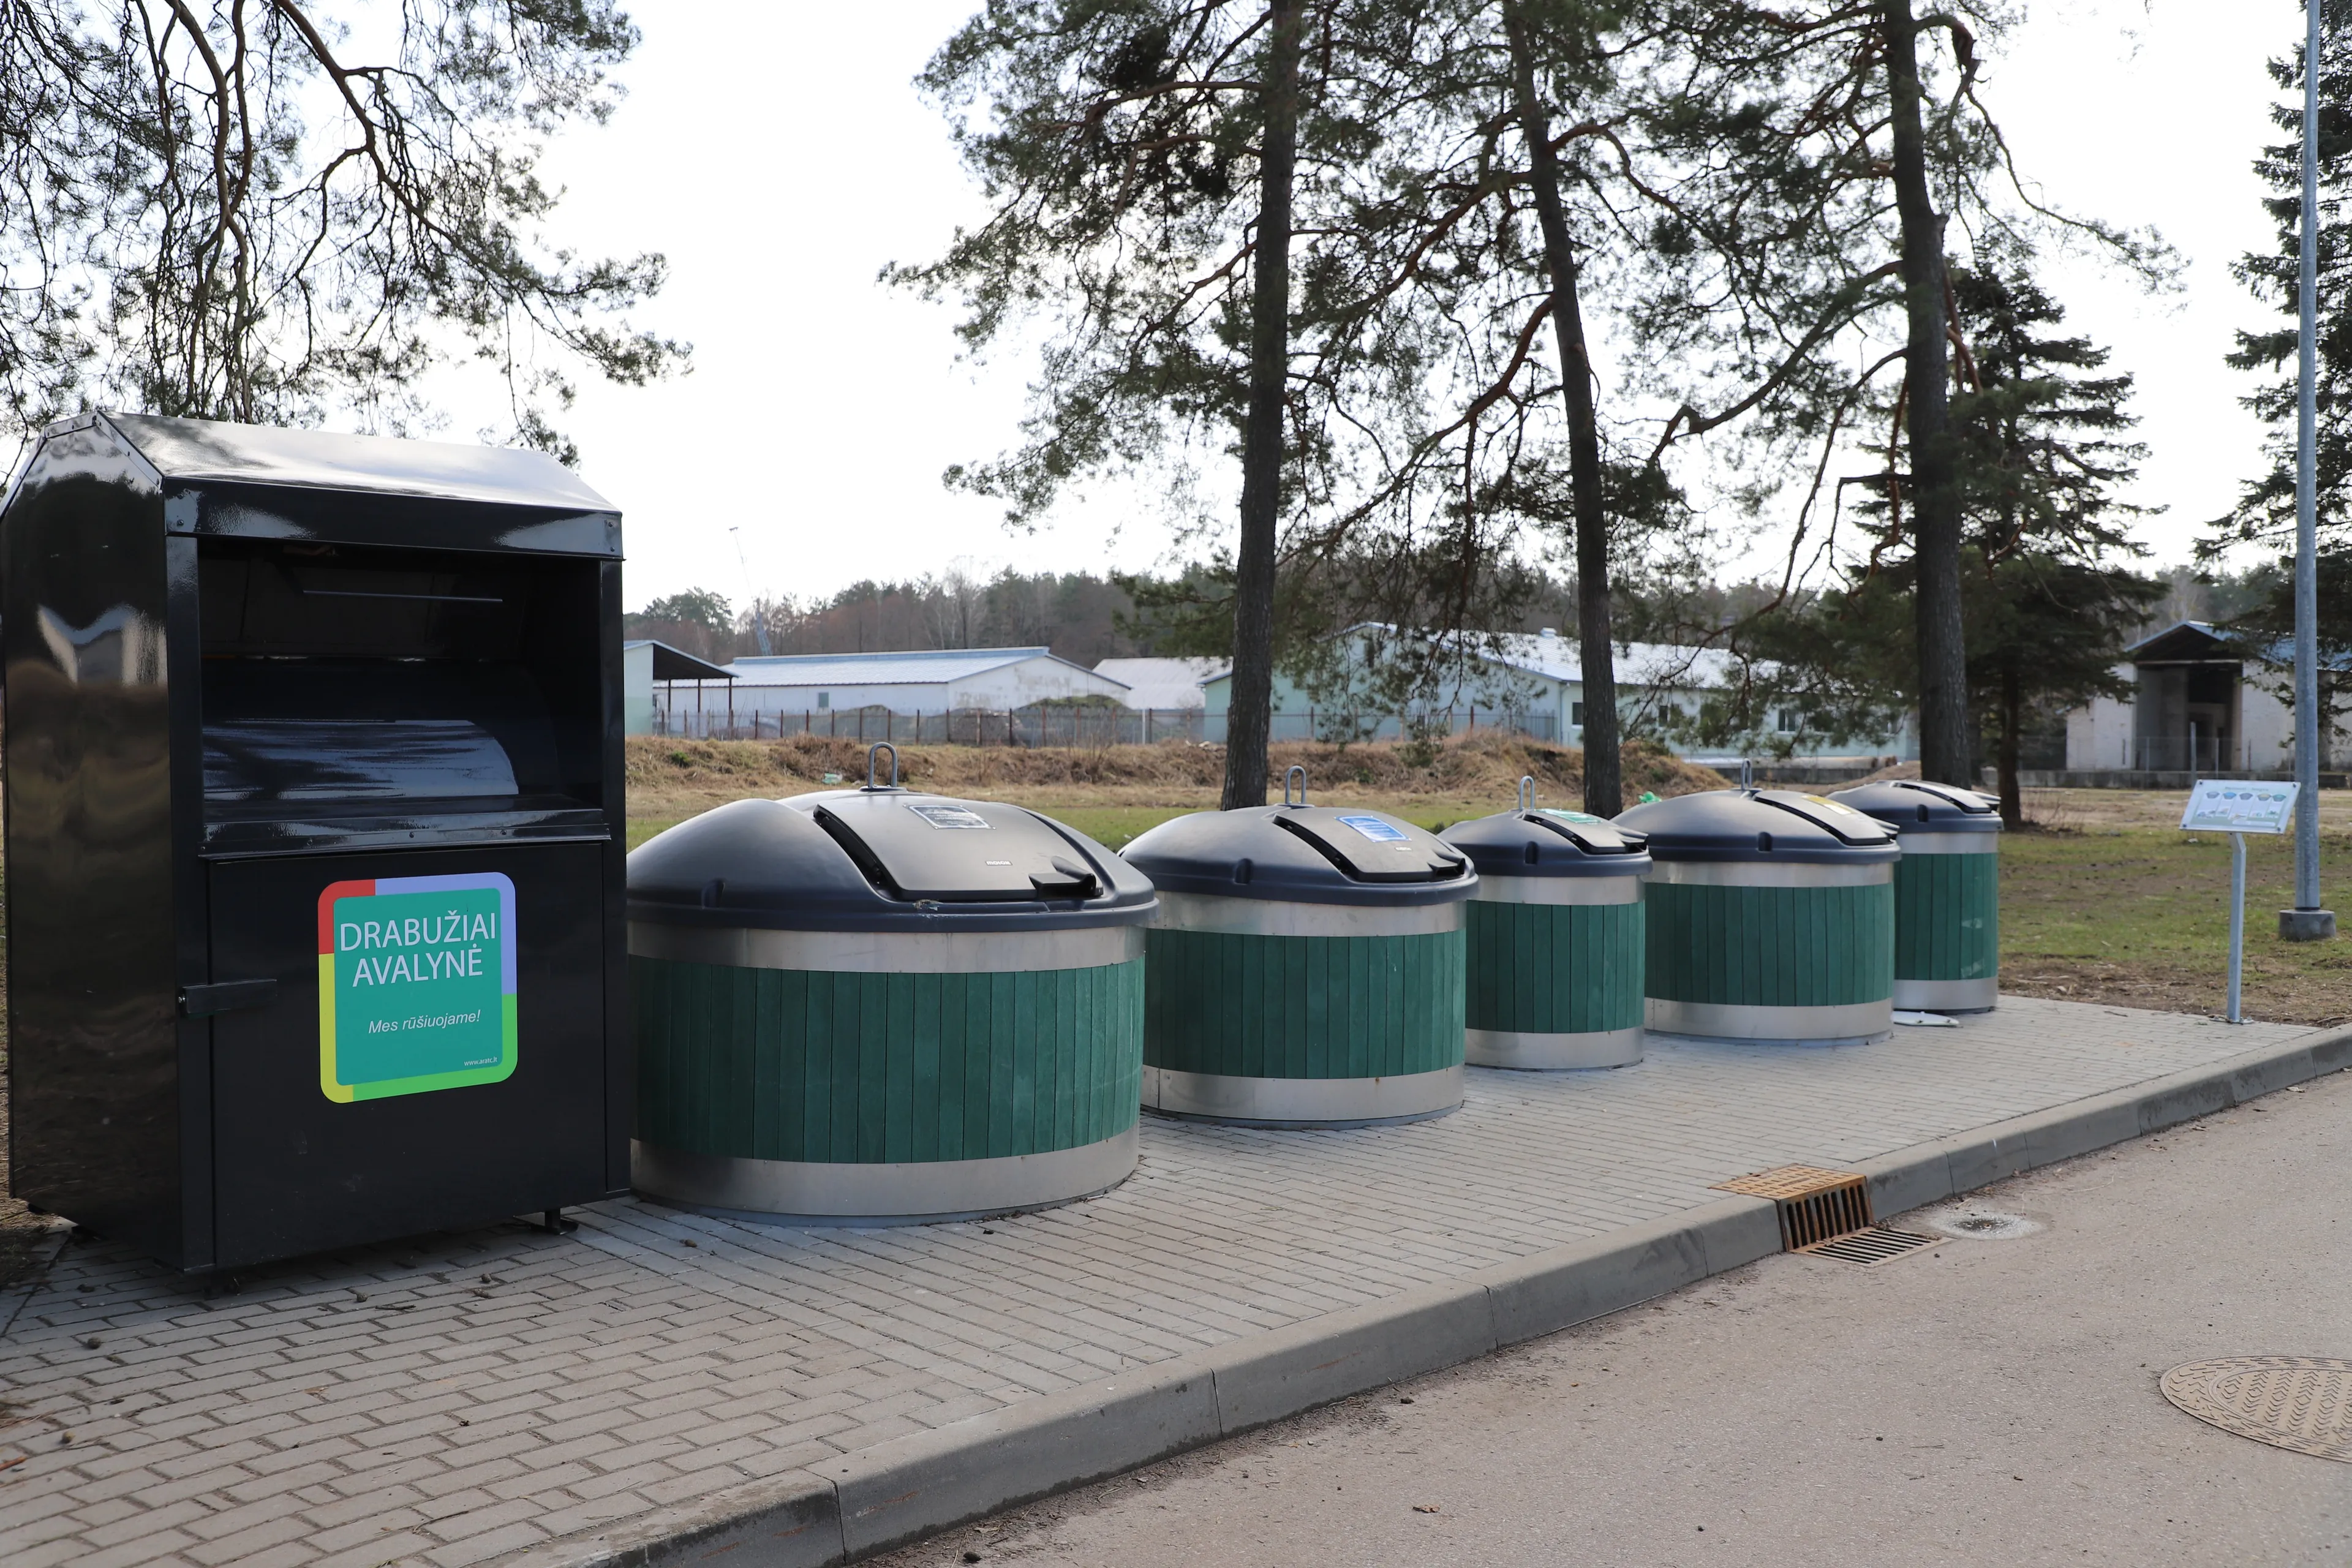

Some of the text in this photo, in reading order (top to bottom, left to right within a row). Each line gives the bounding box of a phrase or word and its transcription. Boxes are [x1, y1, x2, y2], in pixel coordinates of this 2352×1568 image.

[340, 910, 496, 951] DRABUŽIAI
[352, 943, 483, 987] AVALYNĖ
[368, 1009, 481, 1034] Mes rūšiuojame!
[464, 1056, 497, 1066] www.aratc.lt
